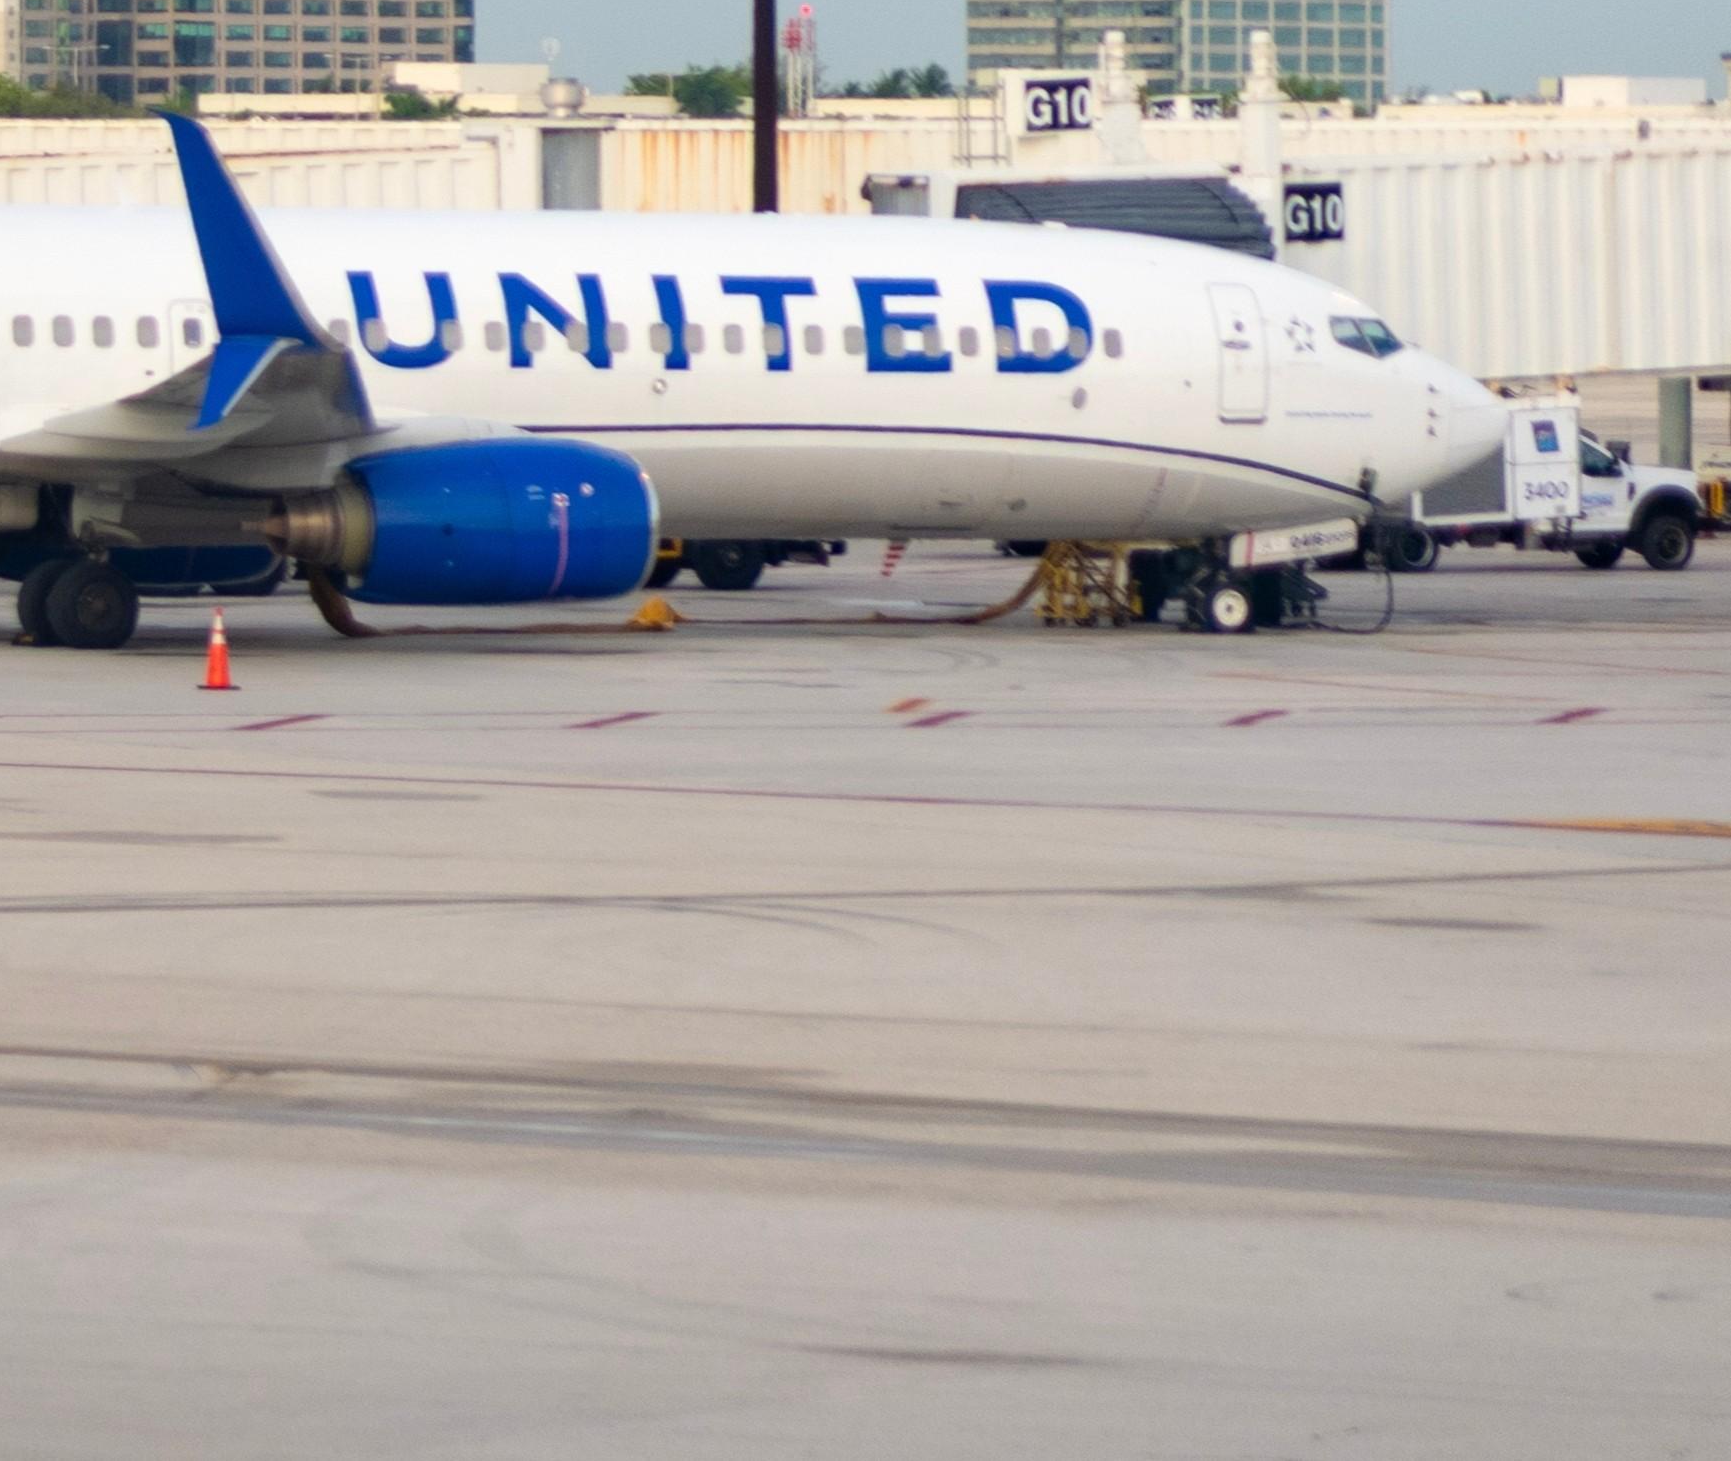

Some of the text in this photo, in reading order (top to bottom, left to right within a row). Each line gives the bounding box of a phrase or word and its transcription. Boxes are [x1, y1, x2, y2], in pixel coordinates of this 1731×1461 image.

[1026, 86, 1092, 128] G10
[1287, 193, 1344, 235] G10
[346, 271, 1094, 373] UNITED
[1524, 480, 1570, 501] 3400
